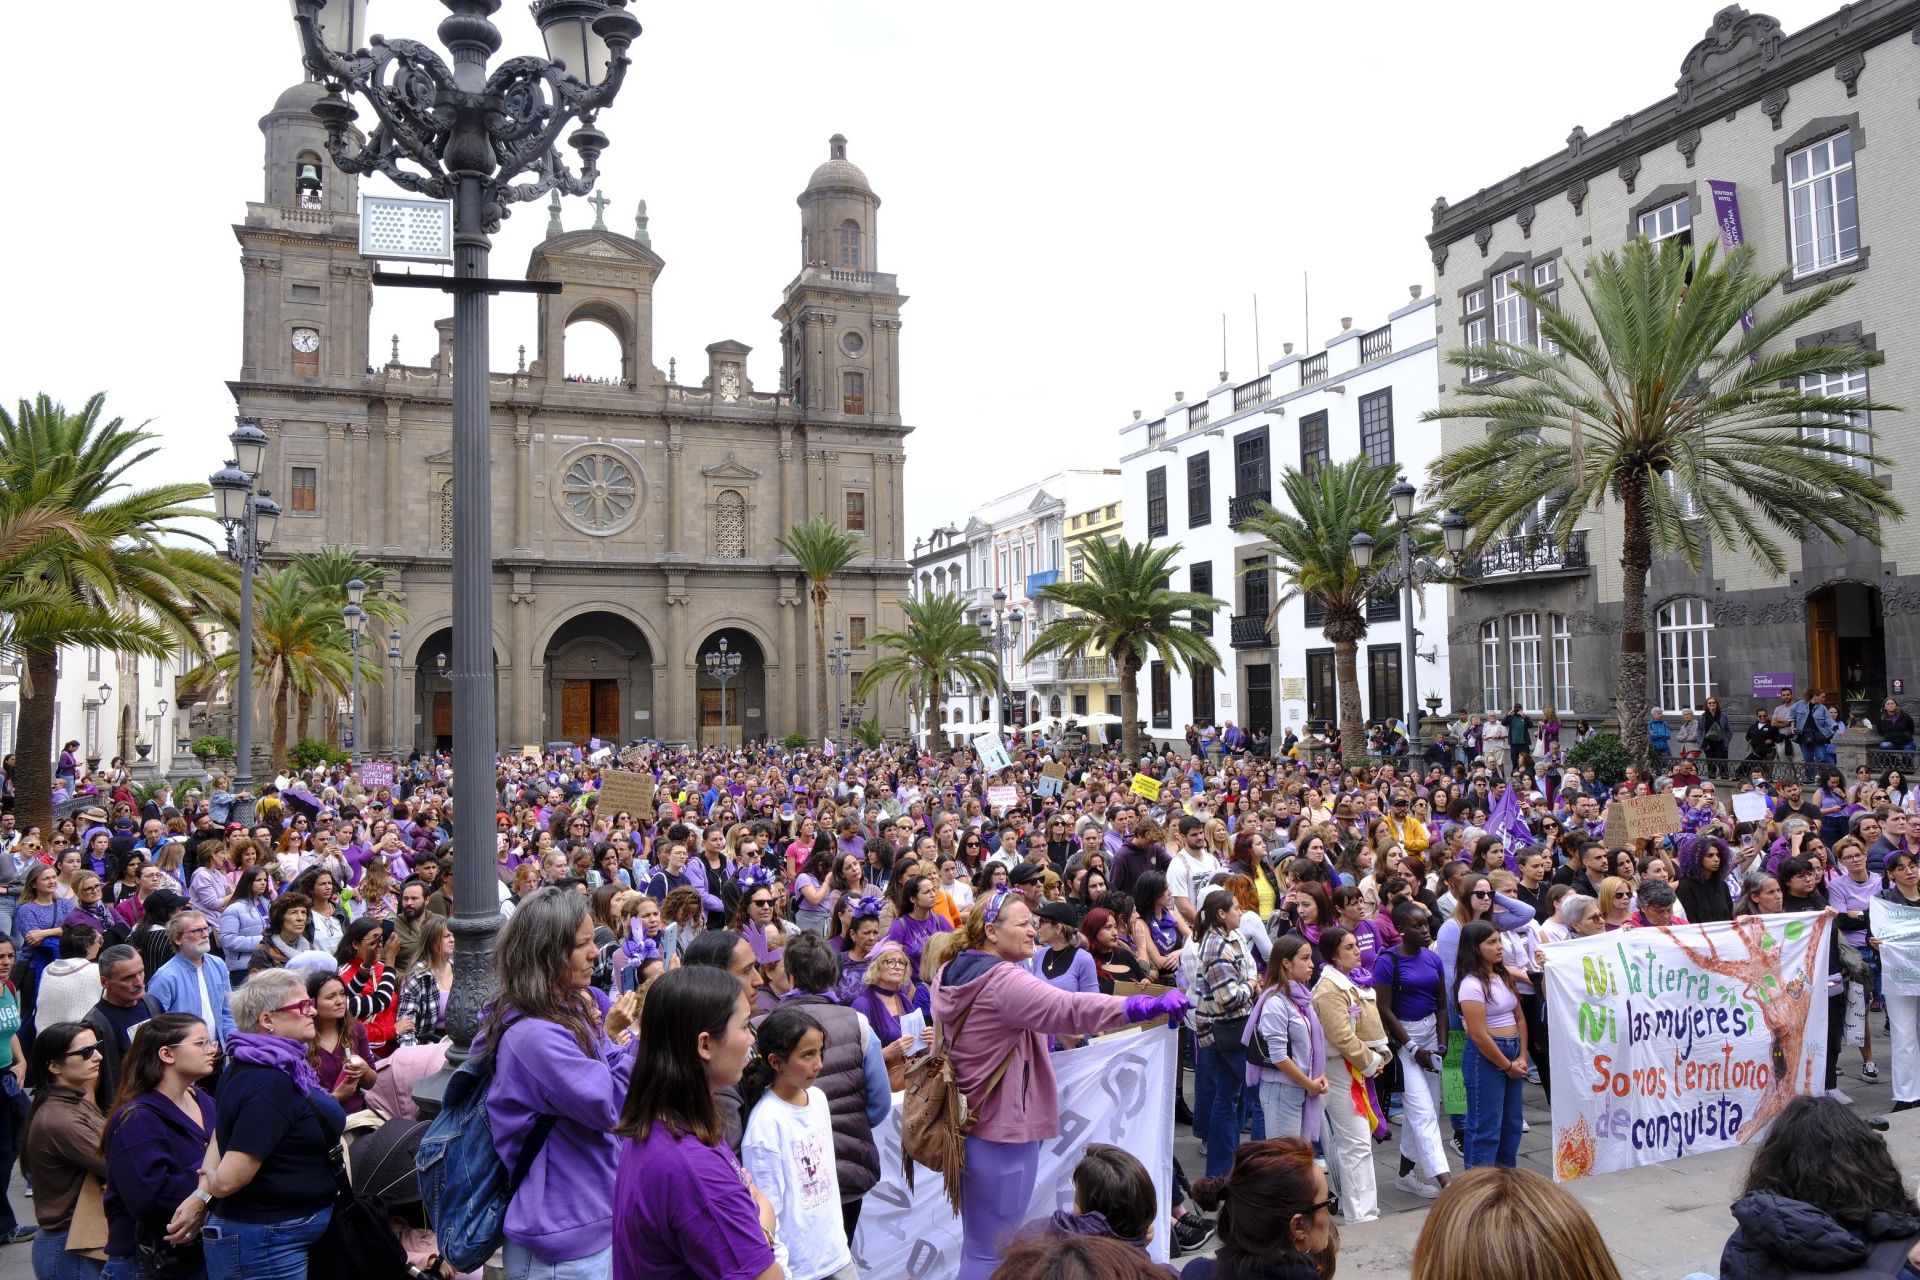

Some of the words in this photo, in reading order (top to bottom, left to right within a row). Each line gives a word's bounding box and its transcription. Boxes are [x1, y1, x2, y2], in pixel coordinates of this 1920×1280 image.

[1723, 218, 1734, 245] MAYOR
[1727, 209, 1736, 225] ANA
[362, 763, 384, 771] JUNTAS
[1636, 804, 1665, 815] CUERPOS
[1583, 955, 1617, 998] Ni
[1617, 941, 1642, 993] la
[1645, 946, 1709, 1001] tierra
[1578, 1001, 1618, 1044] Ni
[1626, 999, 1651, 1047] las
[1655, 1004, 1748, 1061] mujeres
[1591, 1054, 1667, 1100] Somos
[1673, 1038, 1770, 1096] territorio
[1595, 1093, 1631, 1142] de
[1631, 1093, 1743, 1158] conquista
